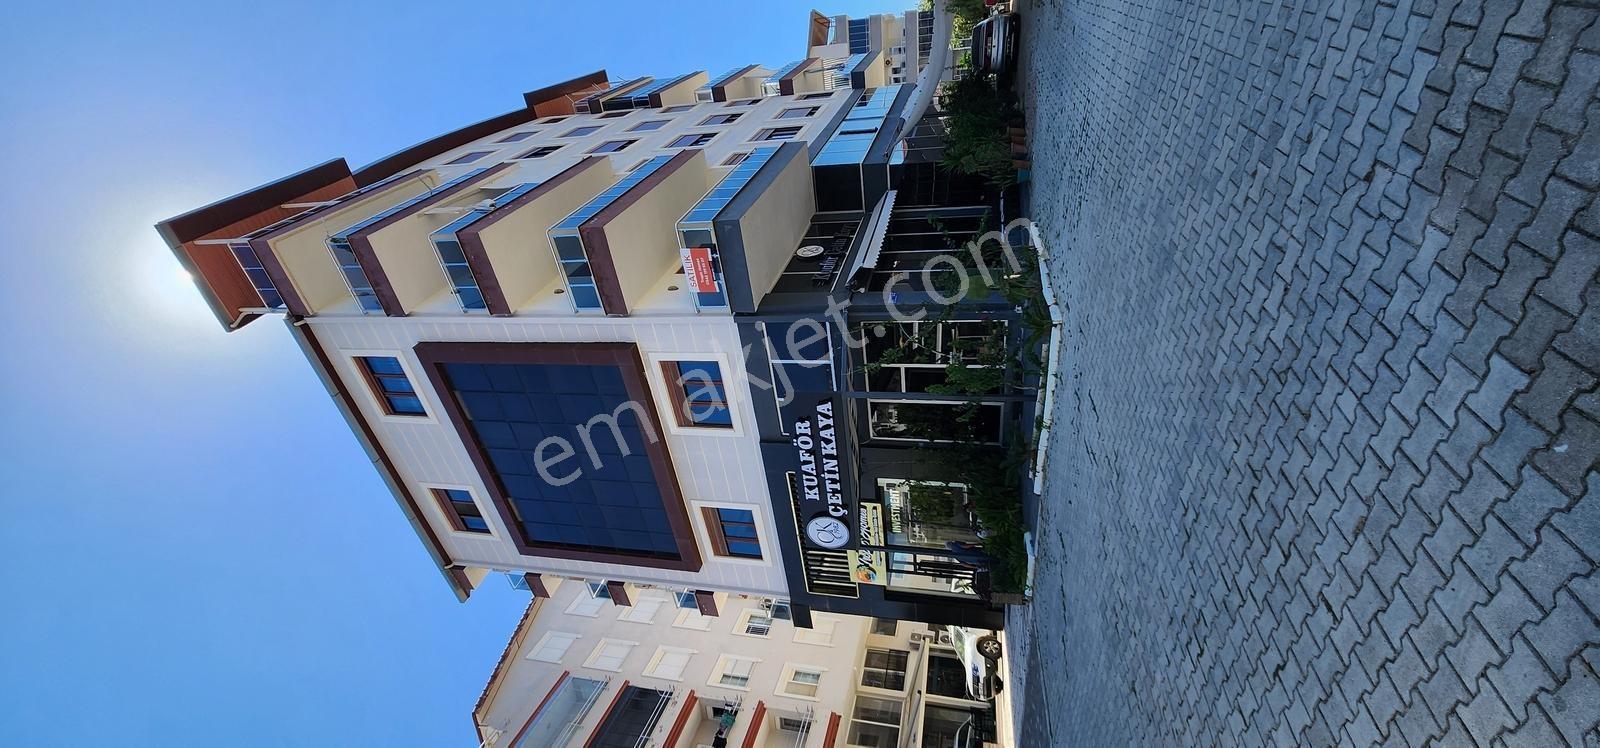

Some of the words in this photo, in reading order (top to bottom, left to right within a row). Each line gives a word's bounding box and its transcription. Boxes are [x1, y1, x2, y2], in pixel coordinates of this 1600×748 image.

[685, 254, 698, 287] SATILIK
[816, 401, 837, 456] KAYA
[793, 420, 820, 501] KUAFÖR
[820, 458, 848, 517] ÇETİN
[889, 488, 902, 533] INVESTMENT
